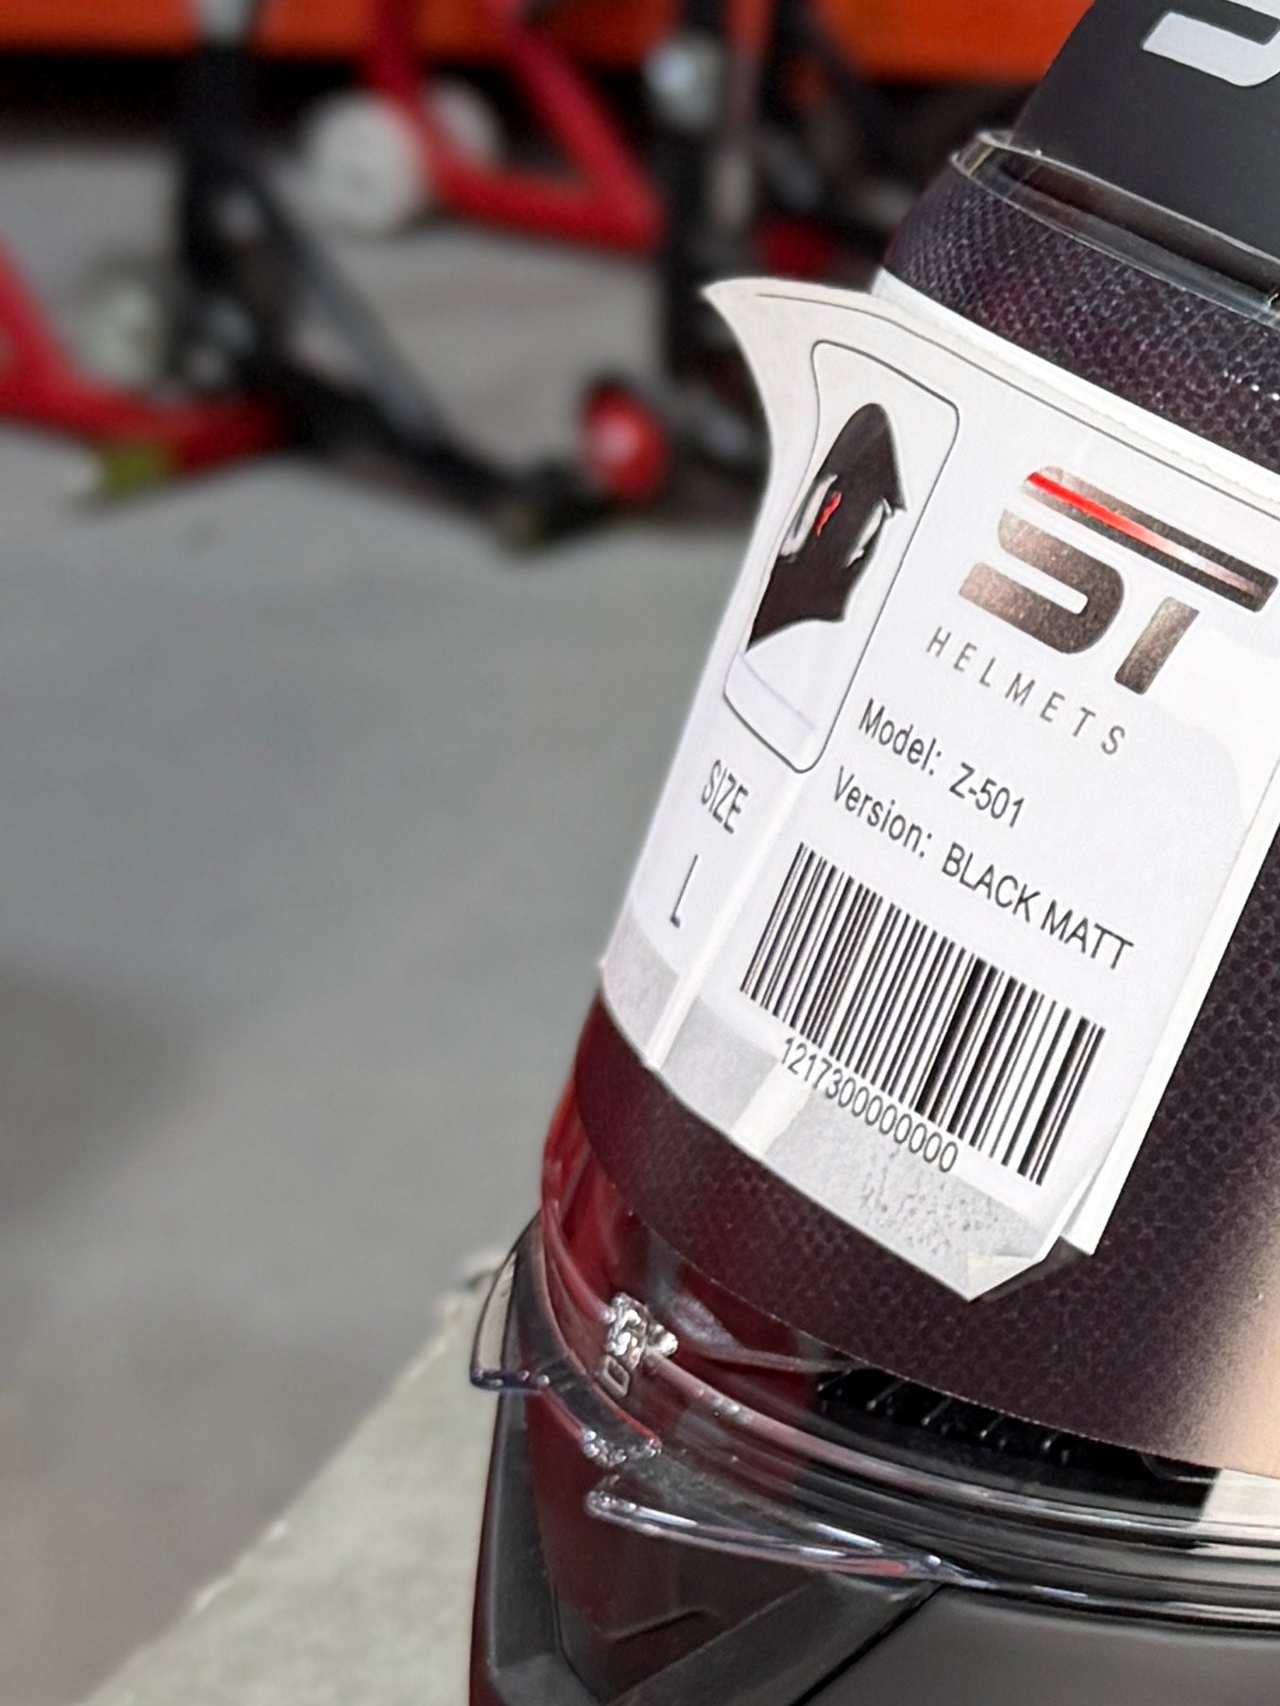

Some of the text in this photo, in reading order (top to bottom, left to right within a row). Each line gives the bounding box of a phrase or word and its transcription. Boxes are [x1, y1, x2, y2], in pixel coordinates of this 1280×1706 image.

[958, 464, 1280, 696] ST
[925, 625, 1127, 756] HELMETS
[700, 758, 750, 835] SIZE
[857, 698, 1027, 829] Model: Z-501
[668, 853, 700, 929] L
[834, 765, 1135, 971] Version: BLACK MATT
[780, 1036, 960, 1174] 1217300000000
